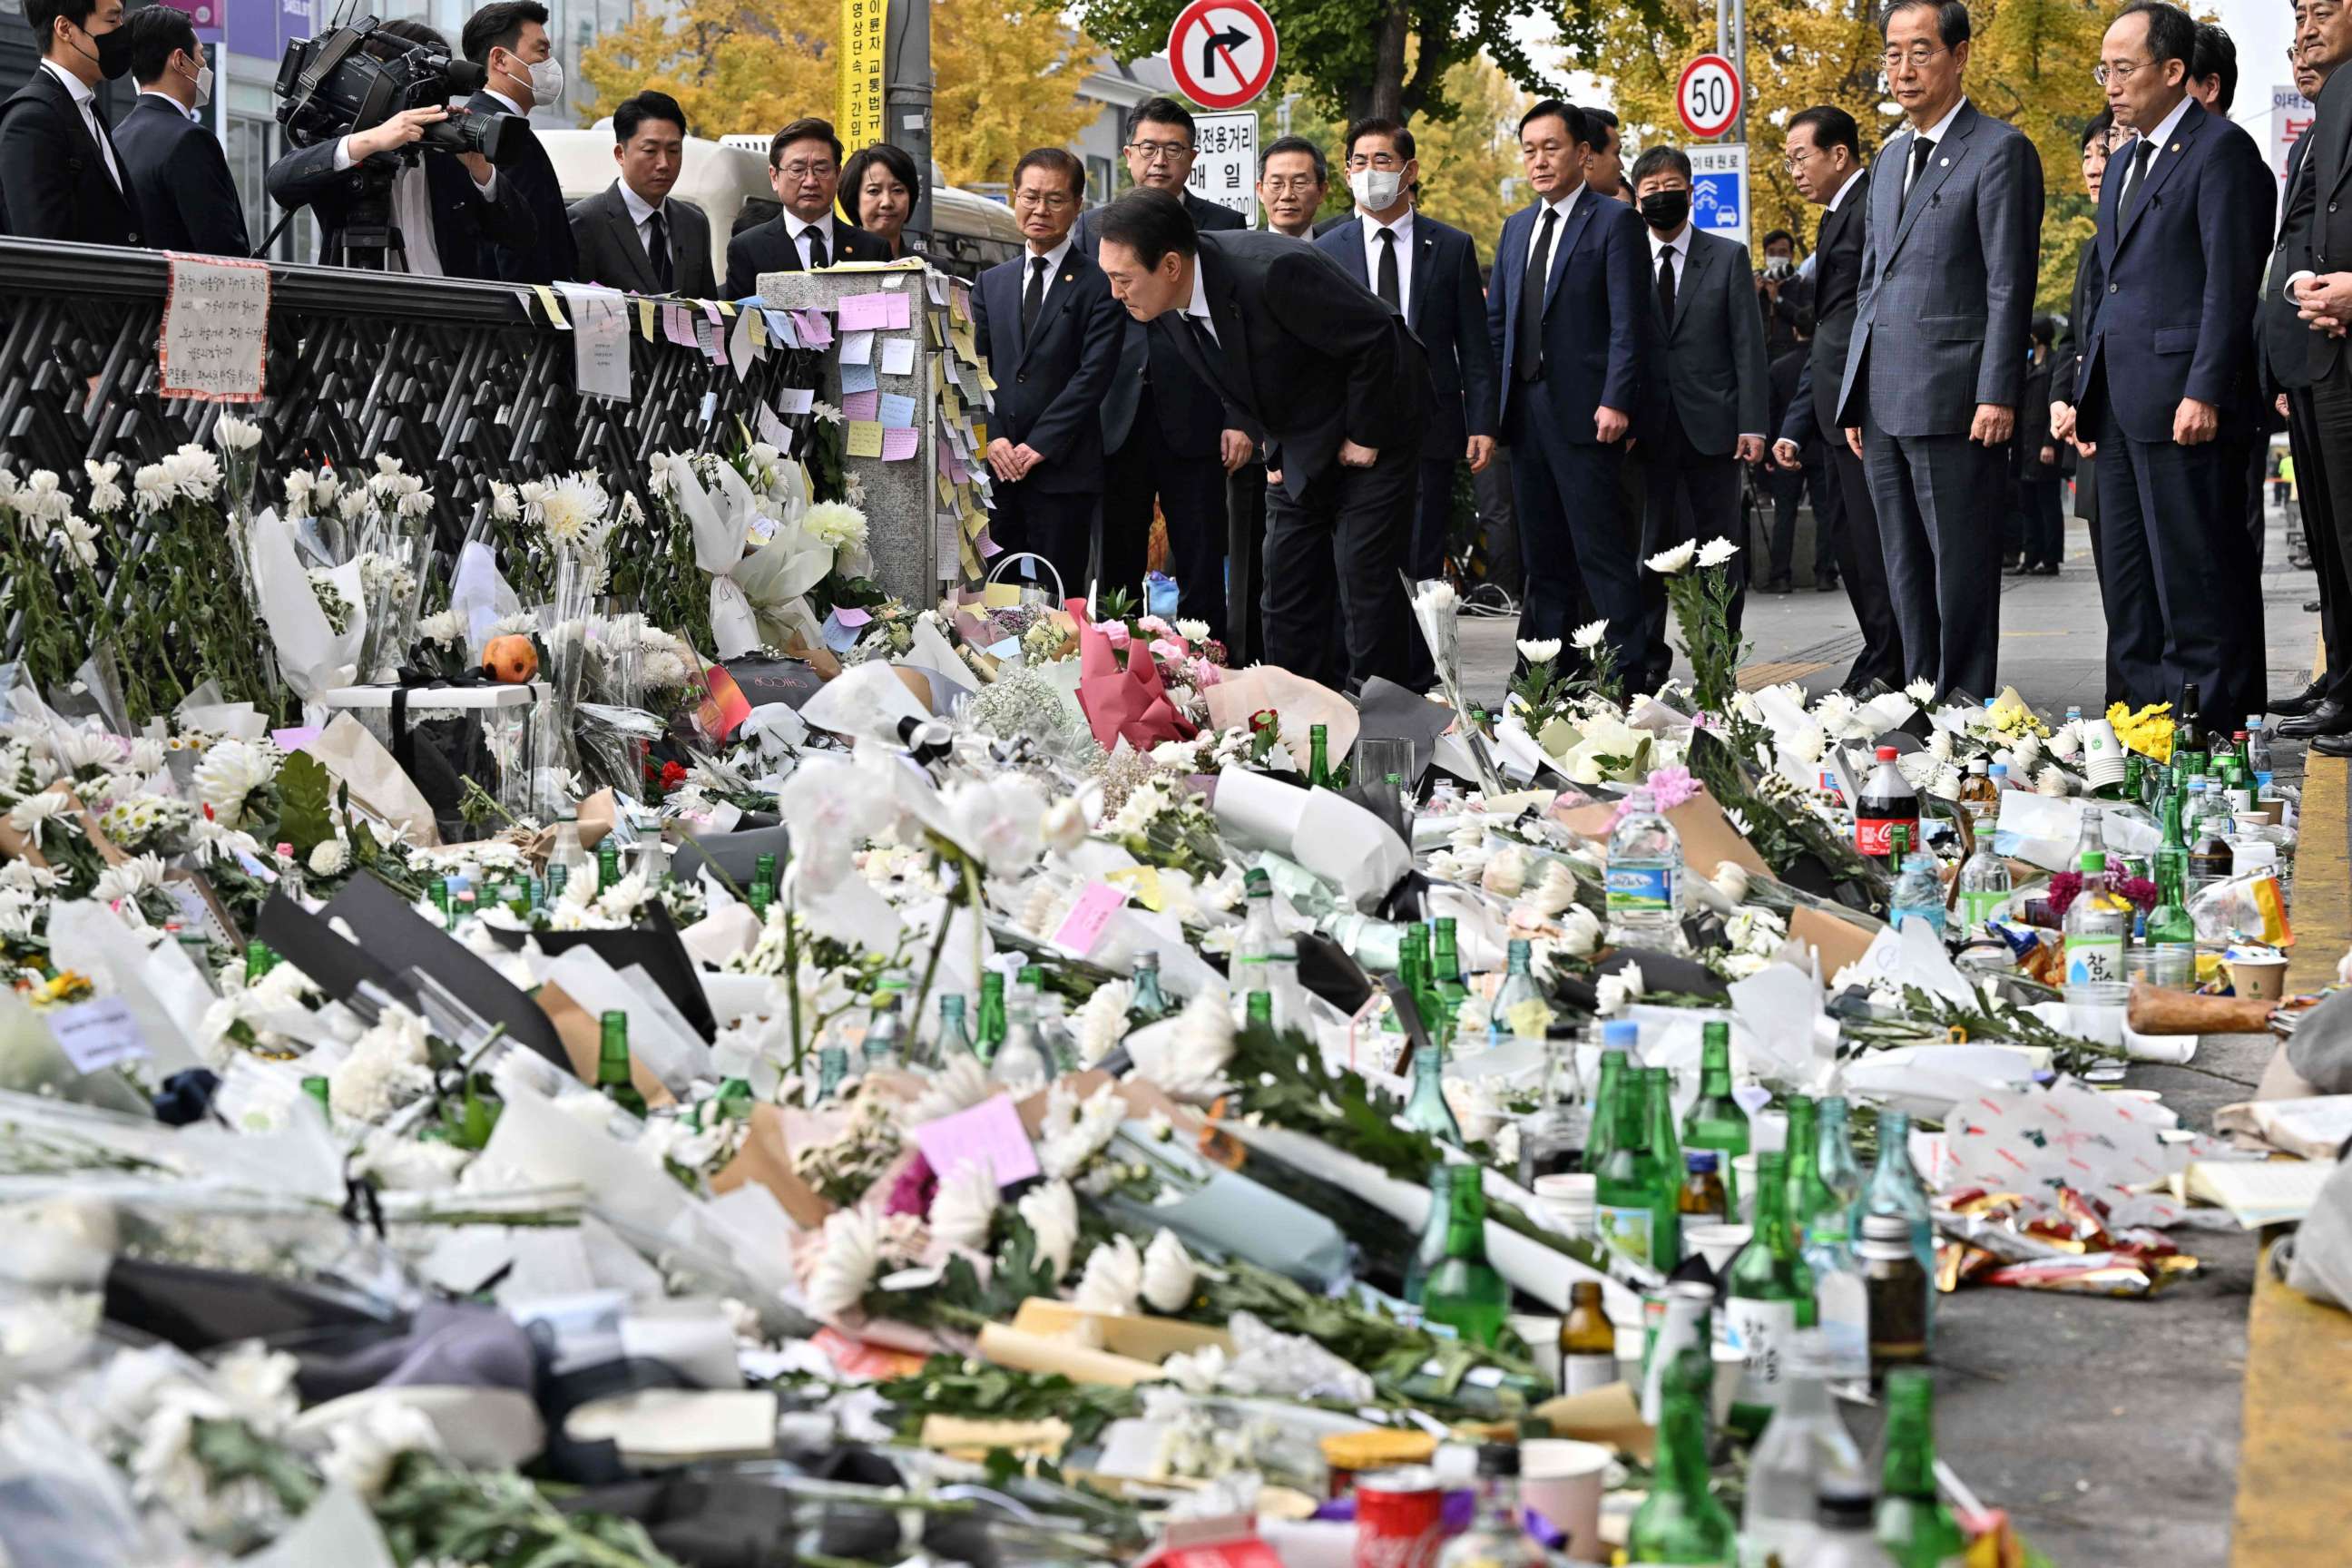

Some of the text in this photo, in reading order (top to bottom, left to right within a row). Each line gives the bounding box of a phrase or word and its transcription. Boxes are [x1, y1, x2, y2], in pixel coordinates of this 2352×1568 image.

[852, 2, 862, 73] 영상단속
[868, 0, 880, 50] 이륜차
[868, 59, 880, 129] 교통법규
[1692, 76, 1725, 117] 50
[1692, 154, 1739, 170] 이태원로
[2088, 952, 2107, 975] 참
